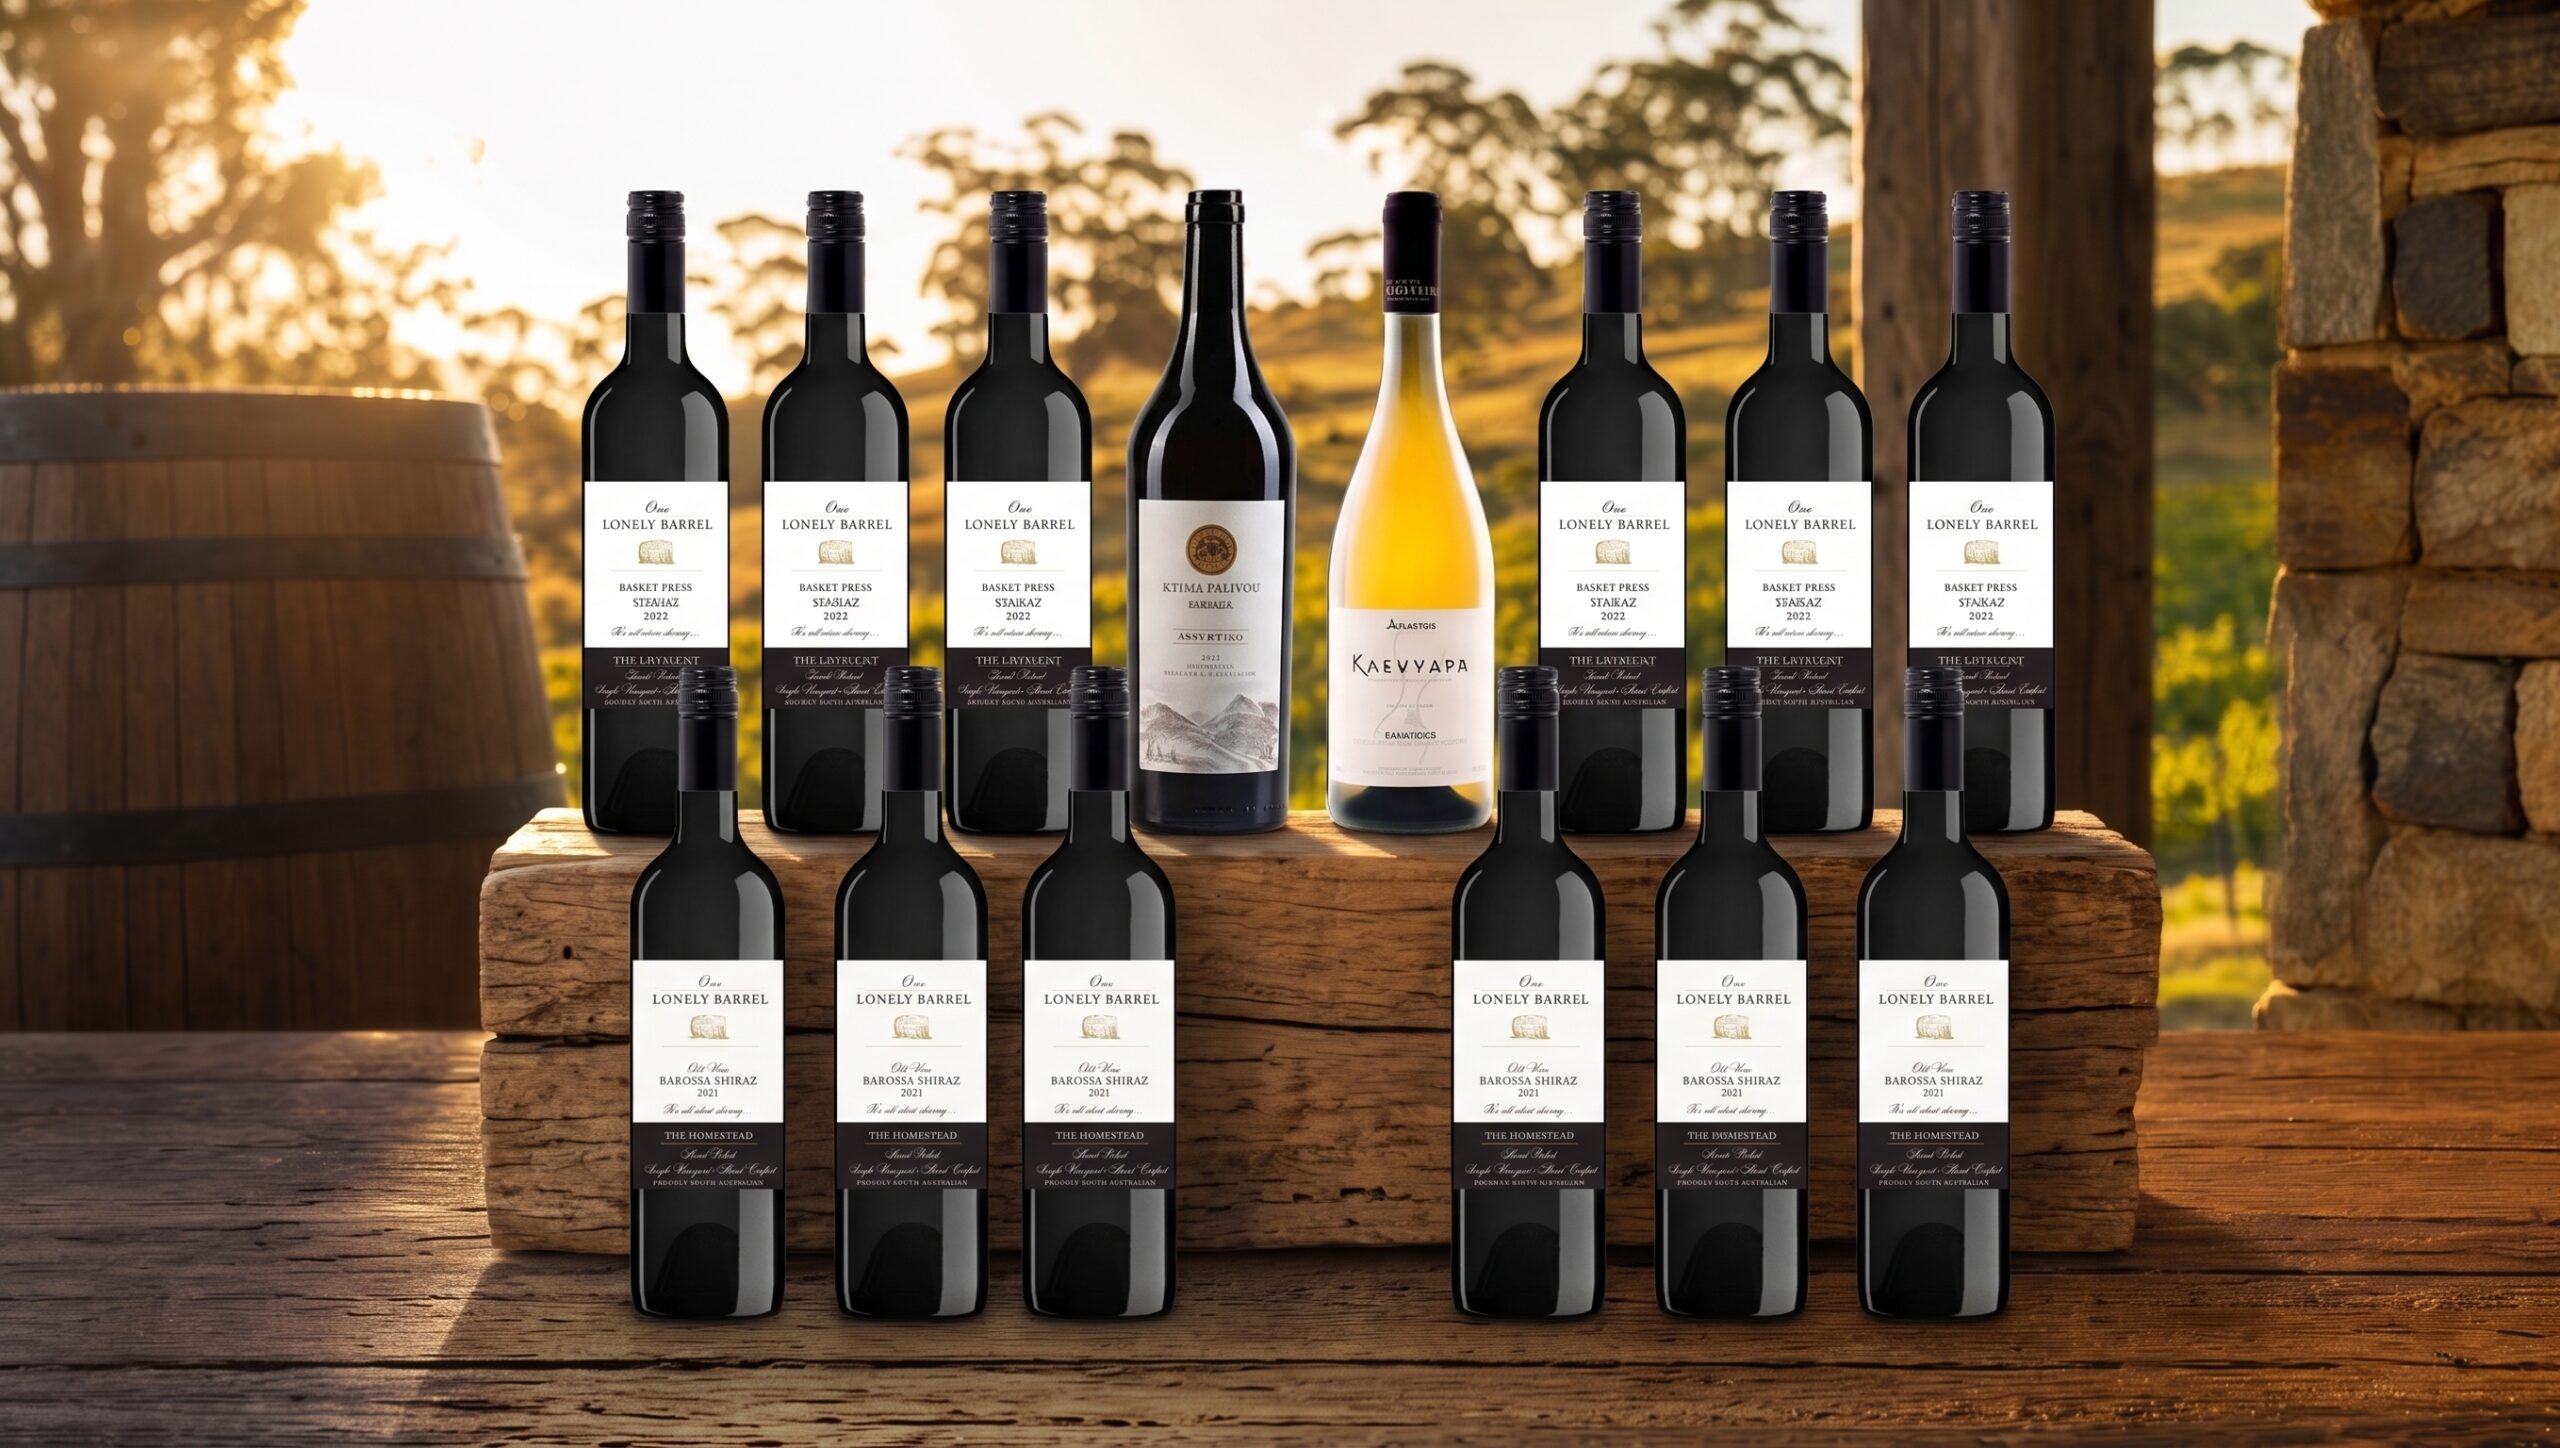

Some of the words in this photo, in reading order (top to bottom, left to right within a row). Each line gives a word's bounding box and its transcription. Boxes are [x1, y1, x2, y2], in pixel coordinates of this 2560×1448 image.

[603, 519, 655, 530] LONELY
[661, 519, 712, 529] BARREL
[782, 519, 835, 530] LONELY
[841, 519, 892, 529] BARREL
[965, 519, 1018, 530] LONELY
[1024, 519, 1075, 529] BARREL
[1560, 519, 1612, 529] LONELY
[1618, 519, 1670, 529] BARREL
[1746, 519, 1798, 530] LONELY
[1804, 519, 1856, 529] BARREL
[1928, 519, 1980, 530] LONELY
[1986, 519, 2038, 529] BARREL
[620, 583, 658, 591] BASKET
[662, 583, 692, 591] PRESS
[800, 583, 838, 591] BASKET
[842, 583, 872, 591] PRESS
[982, 583, 1021, 591] BASKET
[1024, 583, 1055, 591] PRESS
[1162, 582, 1204, 593] KTIMA
[1207, 582, 1261, 593] PALIVOU
[1577, 583, 1616, 591] BASKET
[1619, 583, 1649, 591] PRESS
[1763, 583, 1802, 591] BASKET
[1805, 583, 1835, 591] PRESS
[1945, 583, 1984, 591] BASKET
[1987, 583, 2017, 591] PRESS
[644, 612, 668, 620] 2022
[824, 612, 848, 620] 2022
[1006, 612, 1030, 620] 2022
[1601, 612, 1625, 620] 2022
[1787, 612, 1811, 620] 2022
[1969, 612, 1993, 620] 2022
[613, 656, 635, 664] THE
[793, 656, 816, 664] THE
[976, 656, 999, 664] THE
[1569, 656, 1592, 665] THE
[1756, 656, 1778, 664] THE
[1938, 656, 1961, 666] THE
[653, 994, 709, 1004] LONELY
[714, 994, 768, 1004] BARREL
[857, 994, 912, 1004] LONELY
[918, 994, 971, 1004] BARREL
[1045, 994, 1101, 1004] LONELY
[1106, 994, 1159, 1004] BARREL
[1473, 994, 1529, 1004] LONELY
[1535, 994, 1589, 1004] BARREL
[1677, 994, 1732, 1004] LONELY
[1738, 994, 1791, 1004] BARREL
[1879, 994, 1934, 1004] LONELY
[1940, 994, 1994, 1004] BARREL
[660, 1076, 711, 1085] BAROSSA
[714, 1076, 757, 1085] SHIRAZ
[863, 1076, 914, 1085] BAROSSA
[918, 1076, 960, 1085] SHIRAZ
[1051, 1076, 1102, 1085] BAROSSA
[1106, 1076, 1148, 1085] SHIRAZ
[1480, 1076, 1531, 1085] BAROSSA
[1535, 1076, 1577, 1085] SHIRAZ
[1683, 1076, 1734, 1085] BAROSSA
[1738, 1076, 1781, 1085] SHIRAZ
[1885, 1076, 1936, 1085] BAROSSA
[1940, 1076, 1983, 1085] SHIRAZ
[697, 1089, 718, 1097] 2021
[901, 1088, 922, 1097] 2021
[1089, 1088, 1109, 1097] 2021
[1518, 1088, 1538, 1097] 2021
[1722, 1088, 1742, 1097] 2021
[1923, 1088, 1943, 1097] 2021
